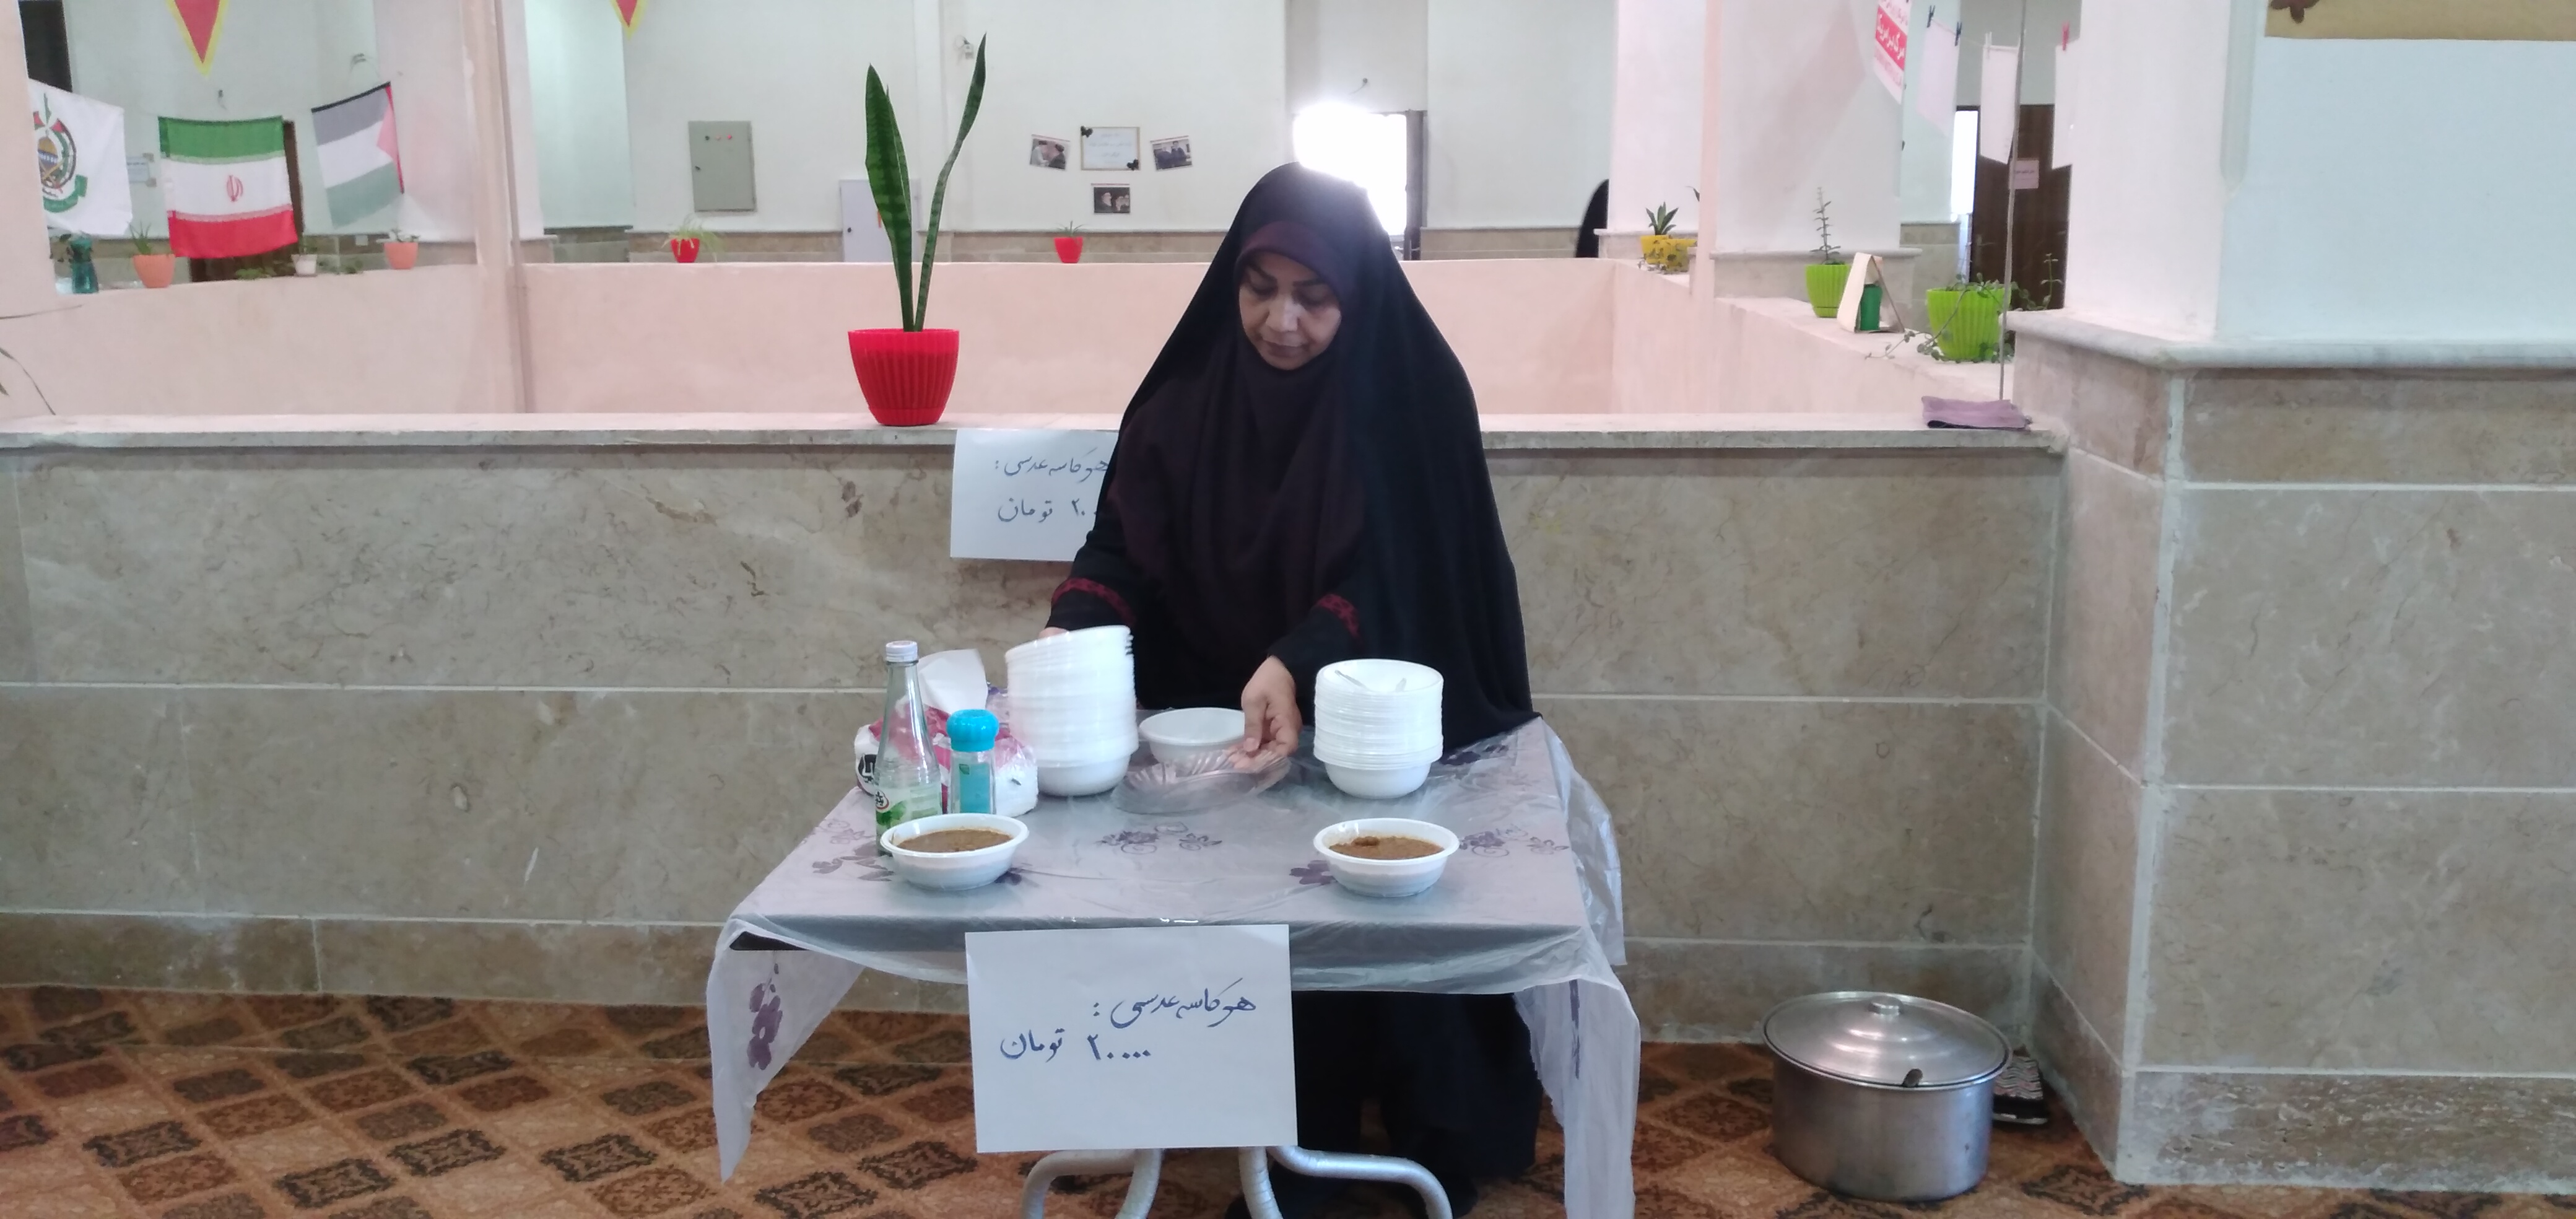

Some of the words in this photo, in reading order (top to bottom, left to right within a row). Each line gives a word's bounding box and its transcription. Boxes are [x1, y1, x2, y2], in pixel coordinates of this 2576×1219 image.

[1049, 447, 1097, 476] کاسه
[998, 497, 1053, 523] تومان
[1110, 994, 1180, 1029] عدسی
[1176, 977, 1243, 1019] کاسه
[1207, 997, 1256, 1028] هر
[1000, 1028, 1065, 1063] تومان
